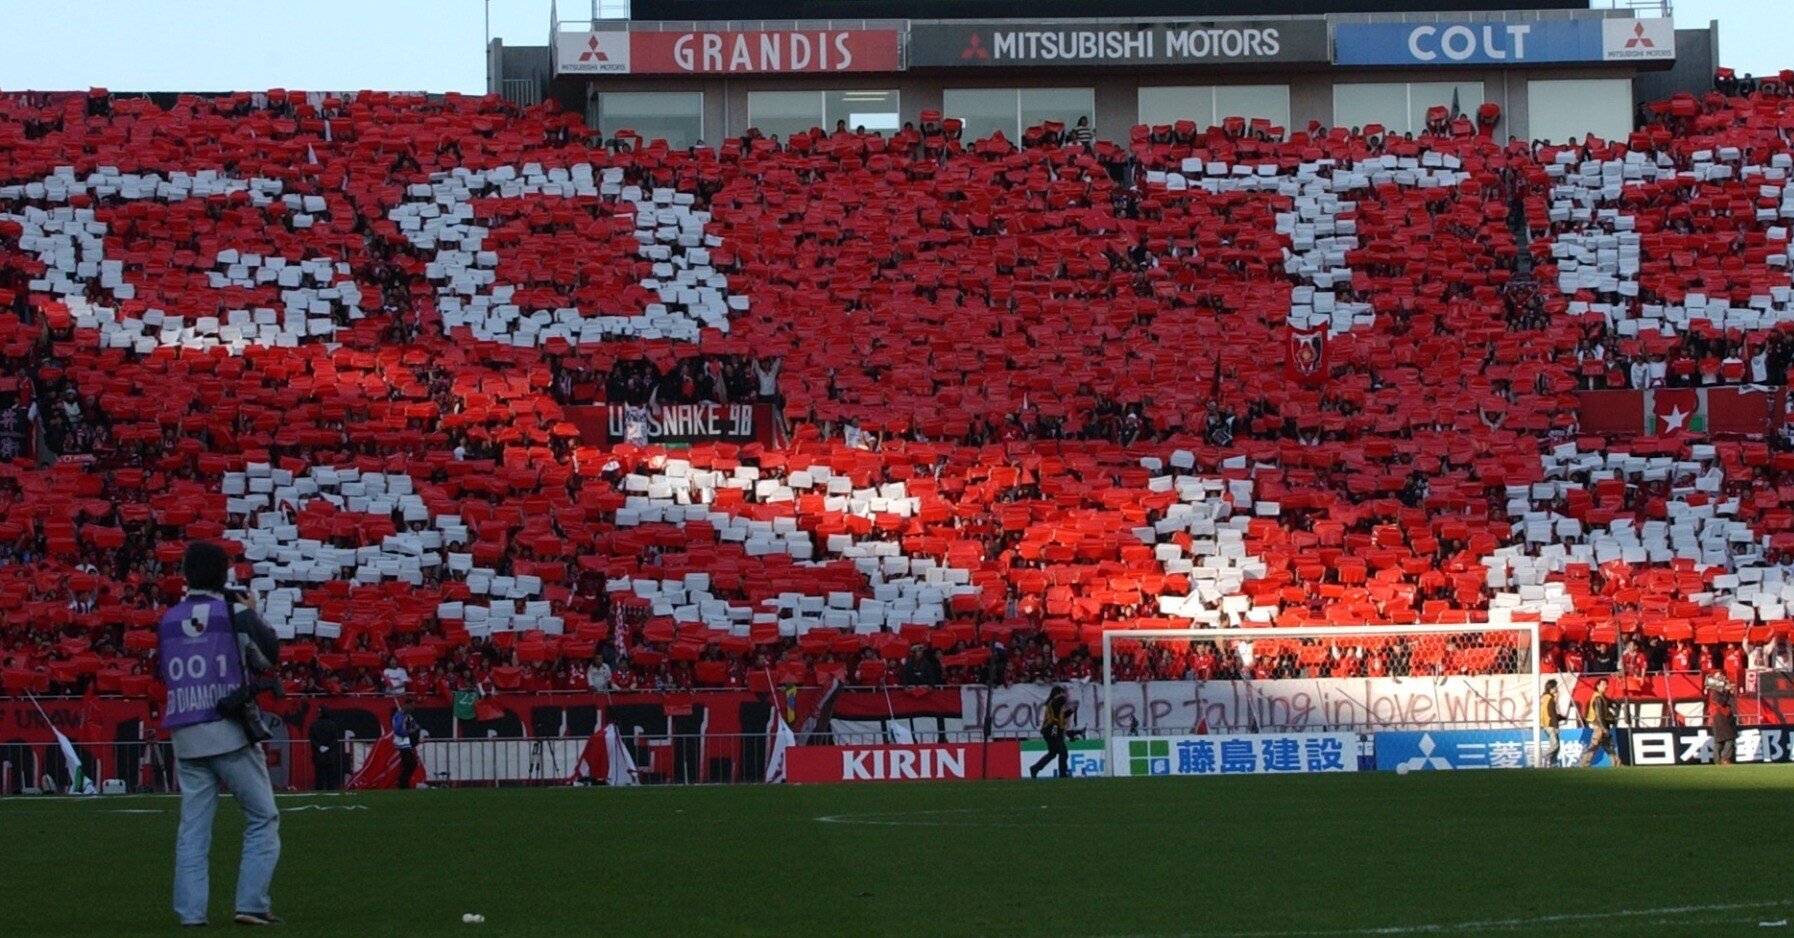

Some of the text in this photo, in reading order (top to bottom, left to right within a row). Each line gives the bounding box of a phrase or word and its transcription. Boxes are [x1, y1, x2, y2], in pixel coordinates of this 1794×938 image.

[674, 32, 852, 71] GRANDIS
[993, 28, 1280, 59] MITSUBISHI MOTORS
[1408, 25, 1531, 61] COLT
[168, 654, 227, 681] 001
[176, 683, 240, 713] DIAMON
[1183, 680, 1317, 732] falling
[1323, 690, 1357, 731] in
[1365, 680, 1438, 727] love
[1177, 737, 1344, 773] 藤島建設
[1633, 728, 1794, 764] 日本郵
[842, 749, 965, 780] KIRIN
